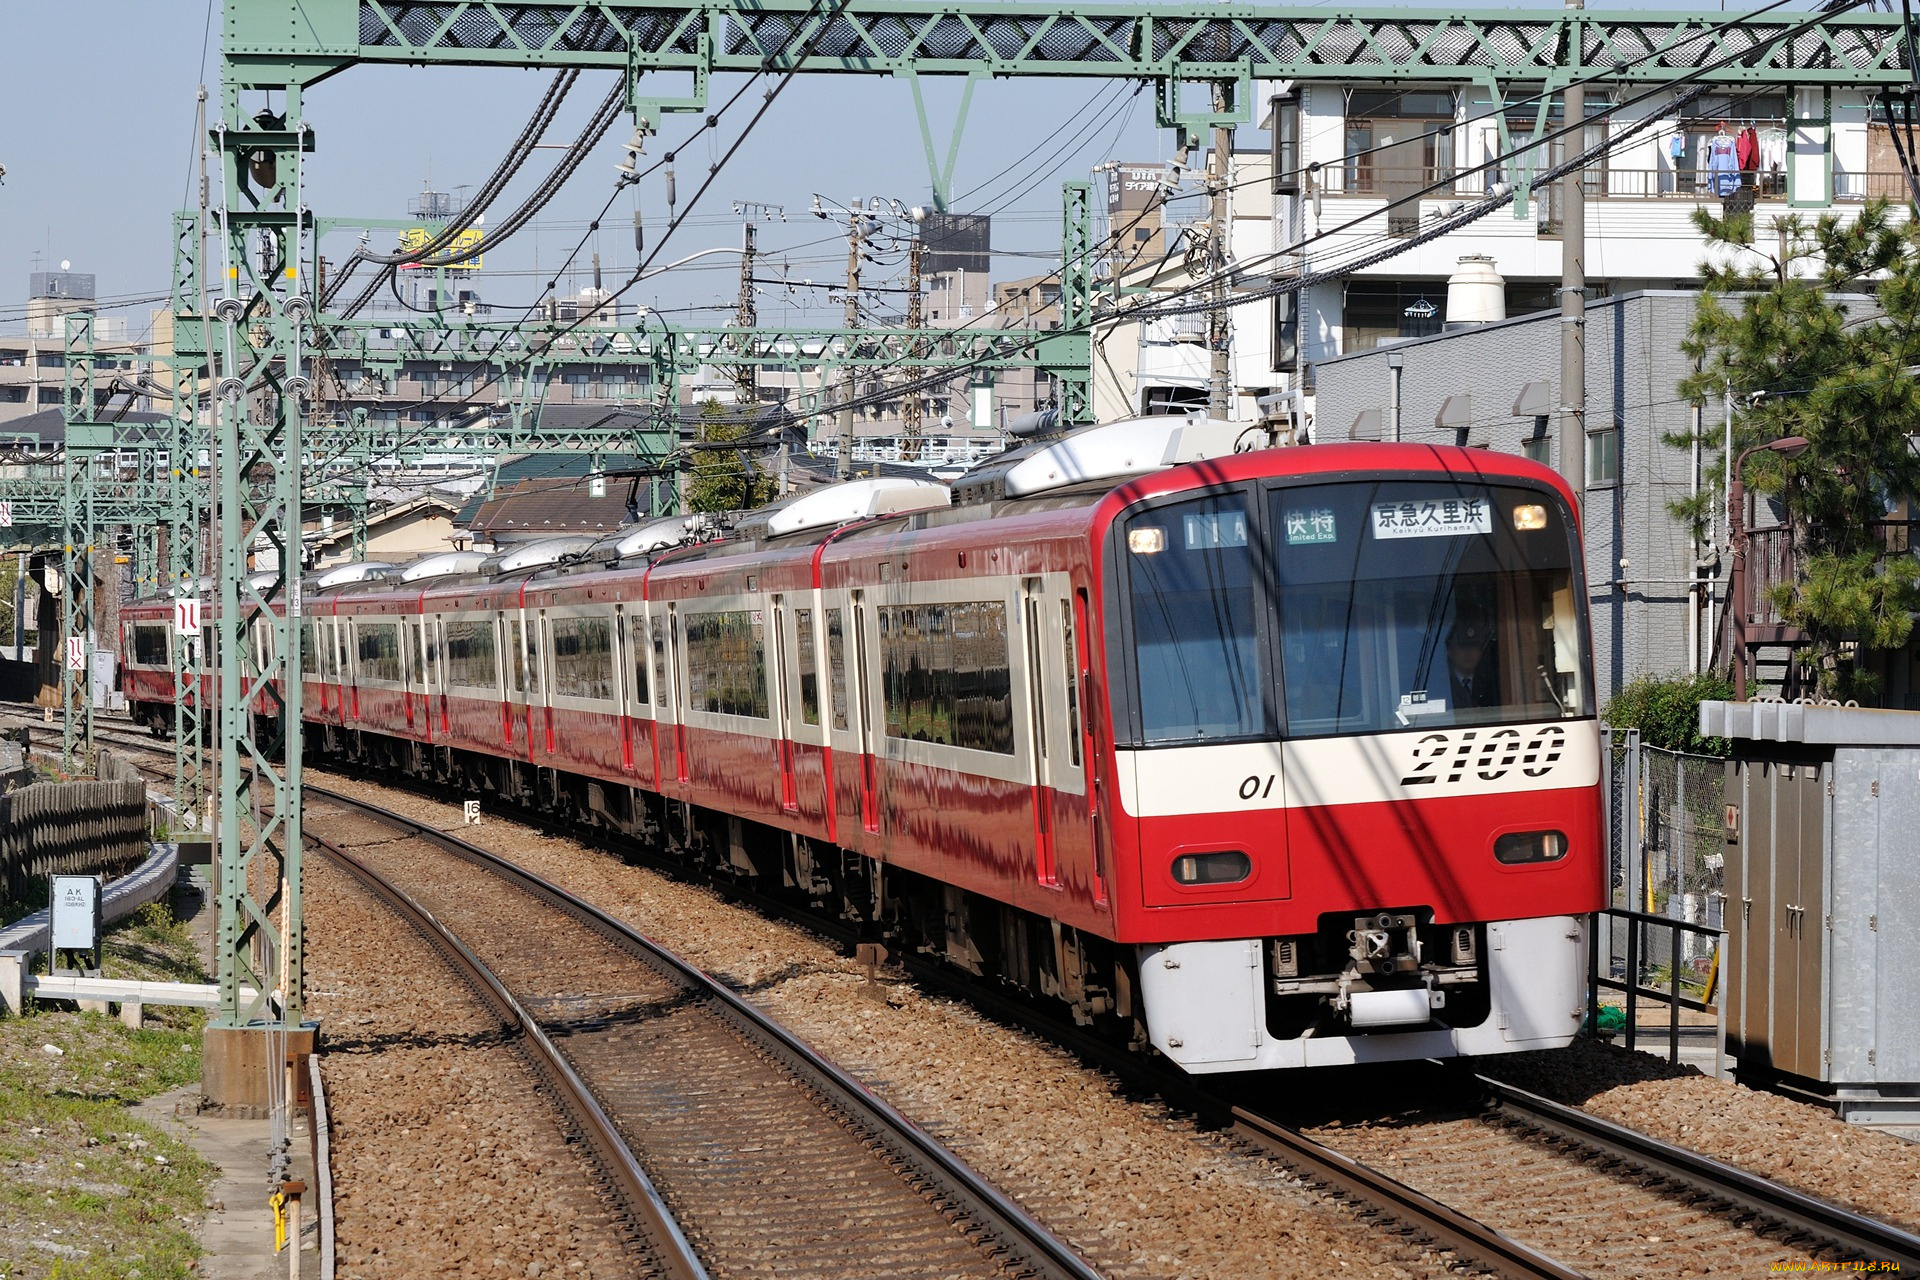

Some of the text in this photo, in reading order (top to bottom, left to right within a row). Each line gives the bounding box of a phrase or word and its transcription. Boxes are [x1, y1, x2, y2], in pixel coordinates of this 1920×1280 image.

[1285, 509, 1334, 534] 快特
[1377, 499, 1483, 528] 京急久里浜
[1286, 532, 1335, 542] Limited Exp.
[1400, 726, 1565, 786] 2100
[1238, 775, 1275, 800] 01
[467, 802, 480, 814] 16
